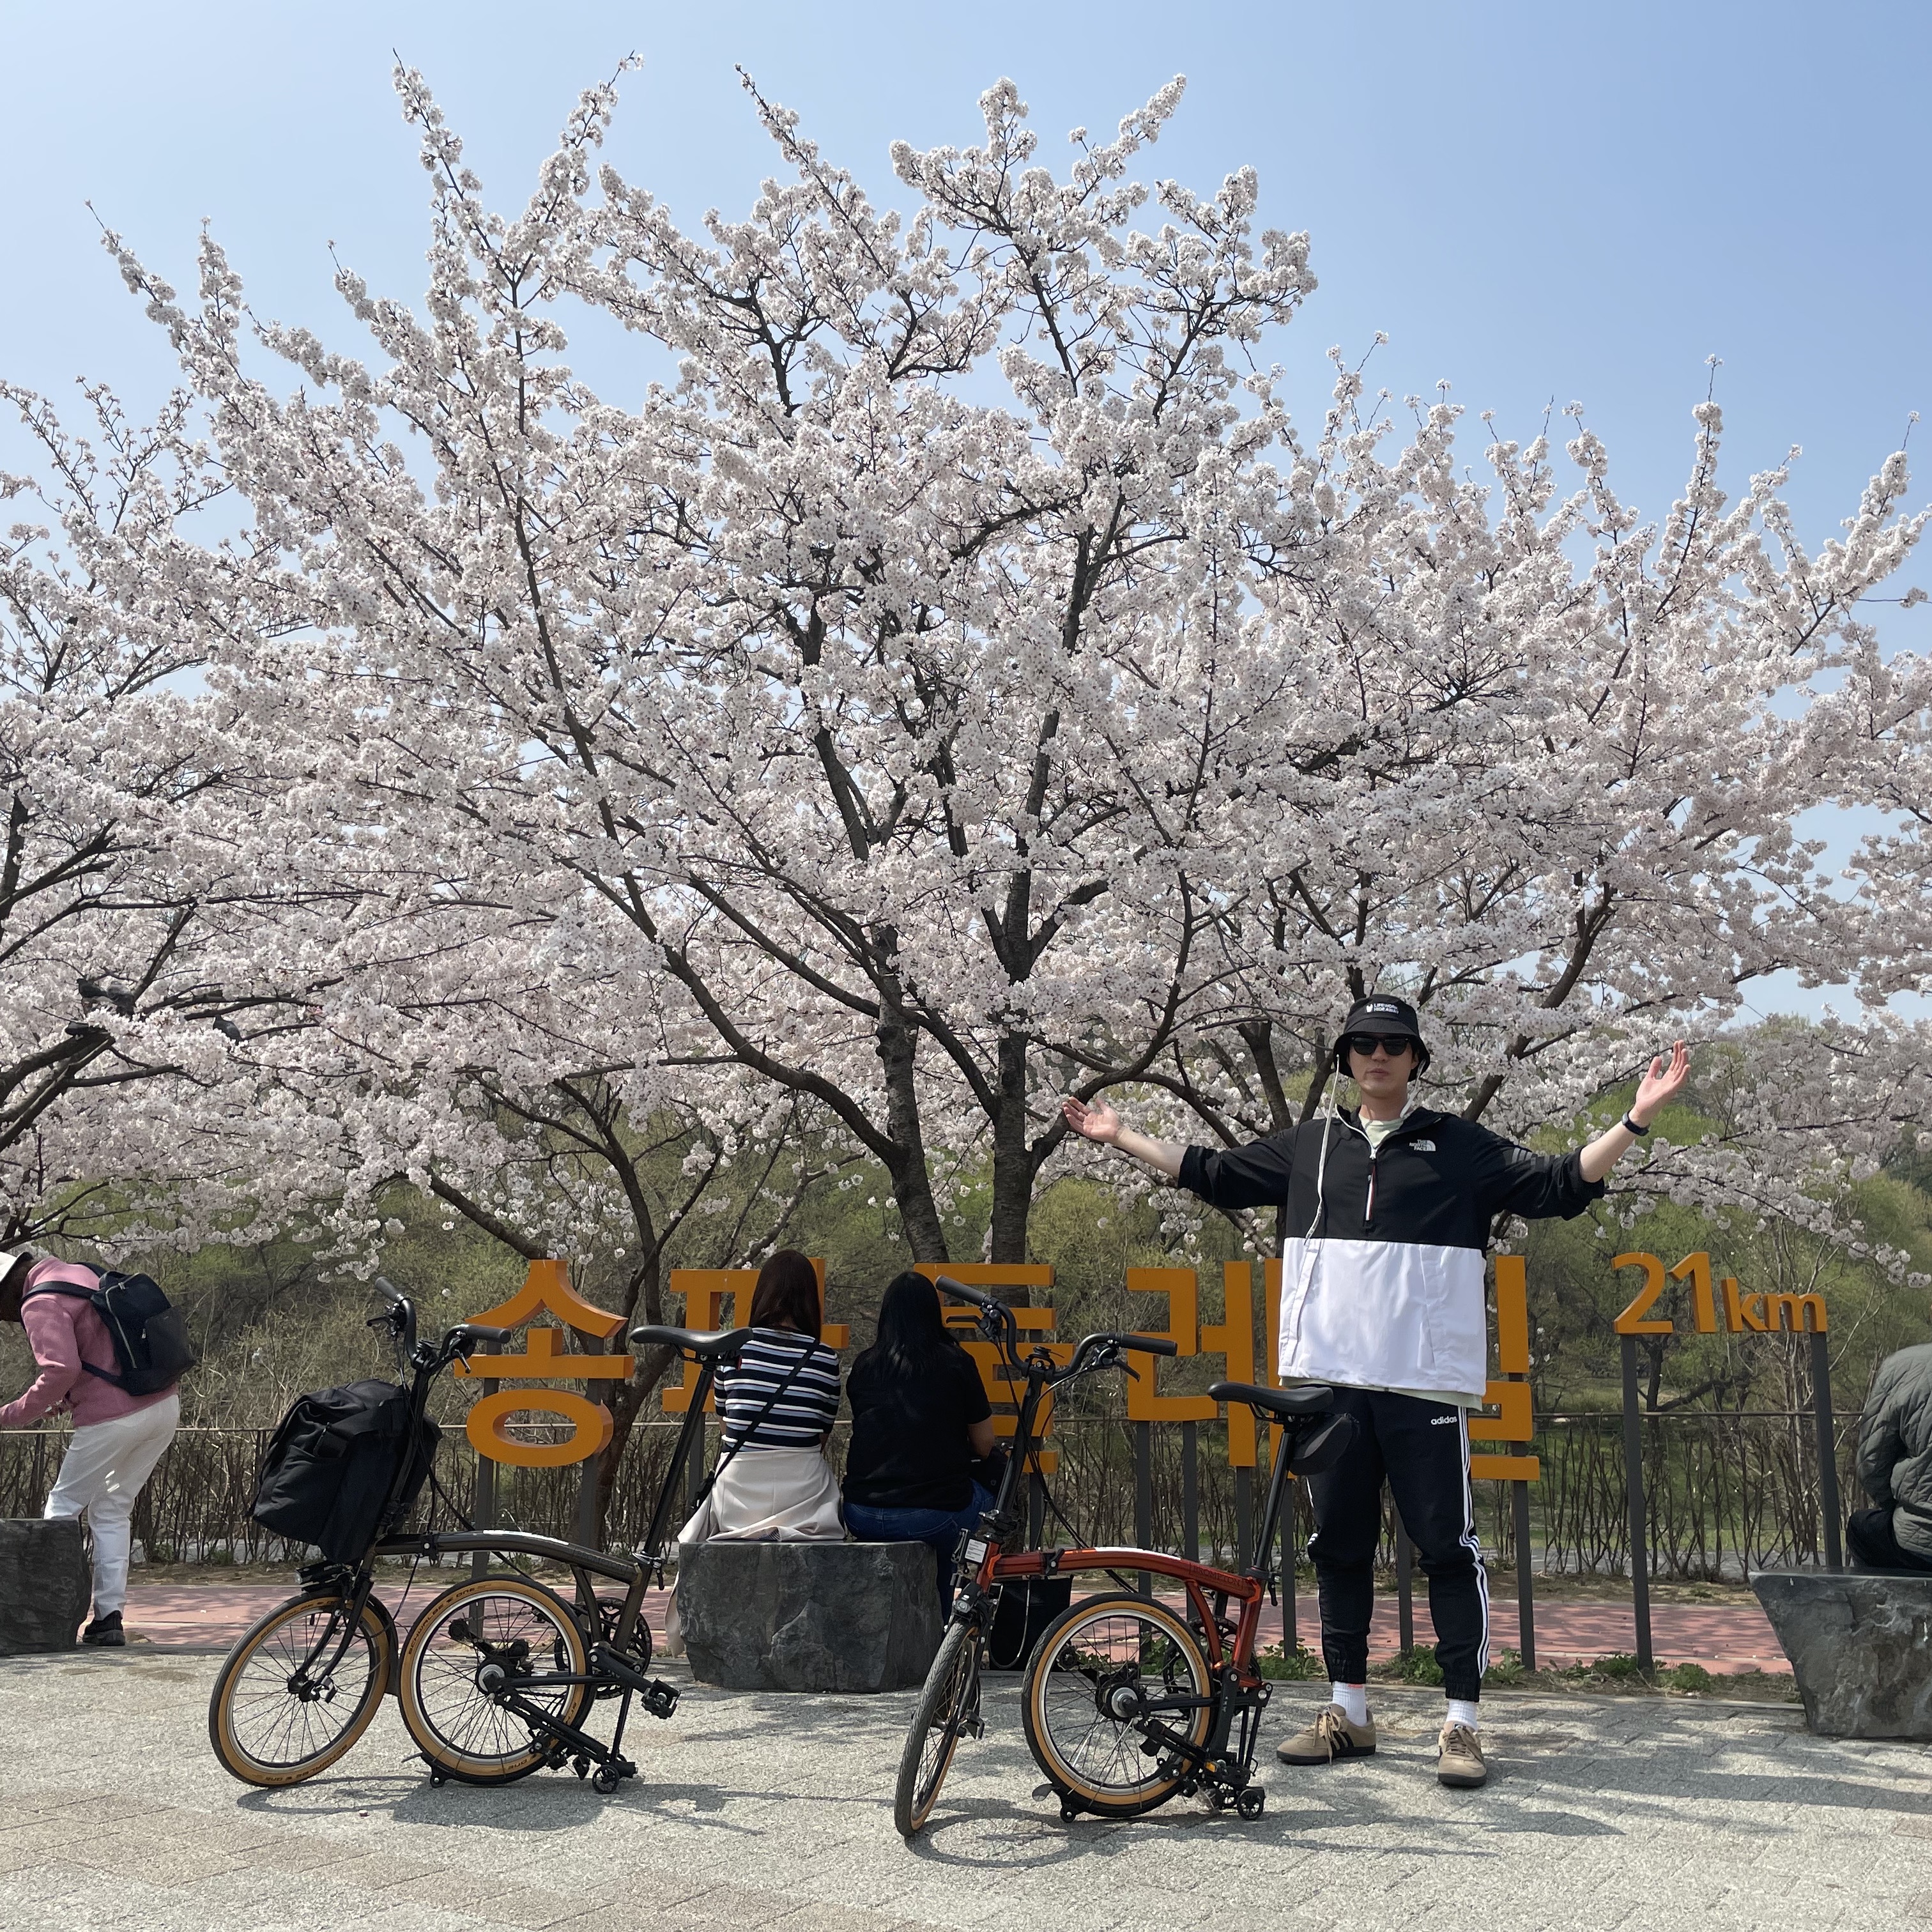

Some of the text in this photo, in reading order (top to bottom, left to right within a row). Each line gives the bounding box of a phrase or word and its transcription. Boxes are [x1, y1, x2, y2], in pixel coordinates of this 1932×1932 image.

[1611, 1251, 1827, 1335] 21km
[1430, 1415, 1457, 1425] adidas
[1190, 1563, 1241, 1586] BROMPTON
[408, 1604, 444, 1655] SCHWALBE
